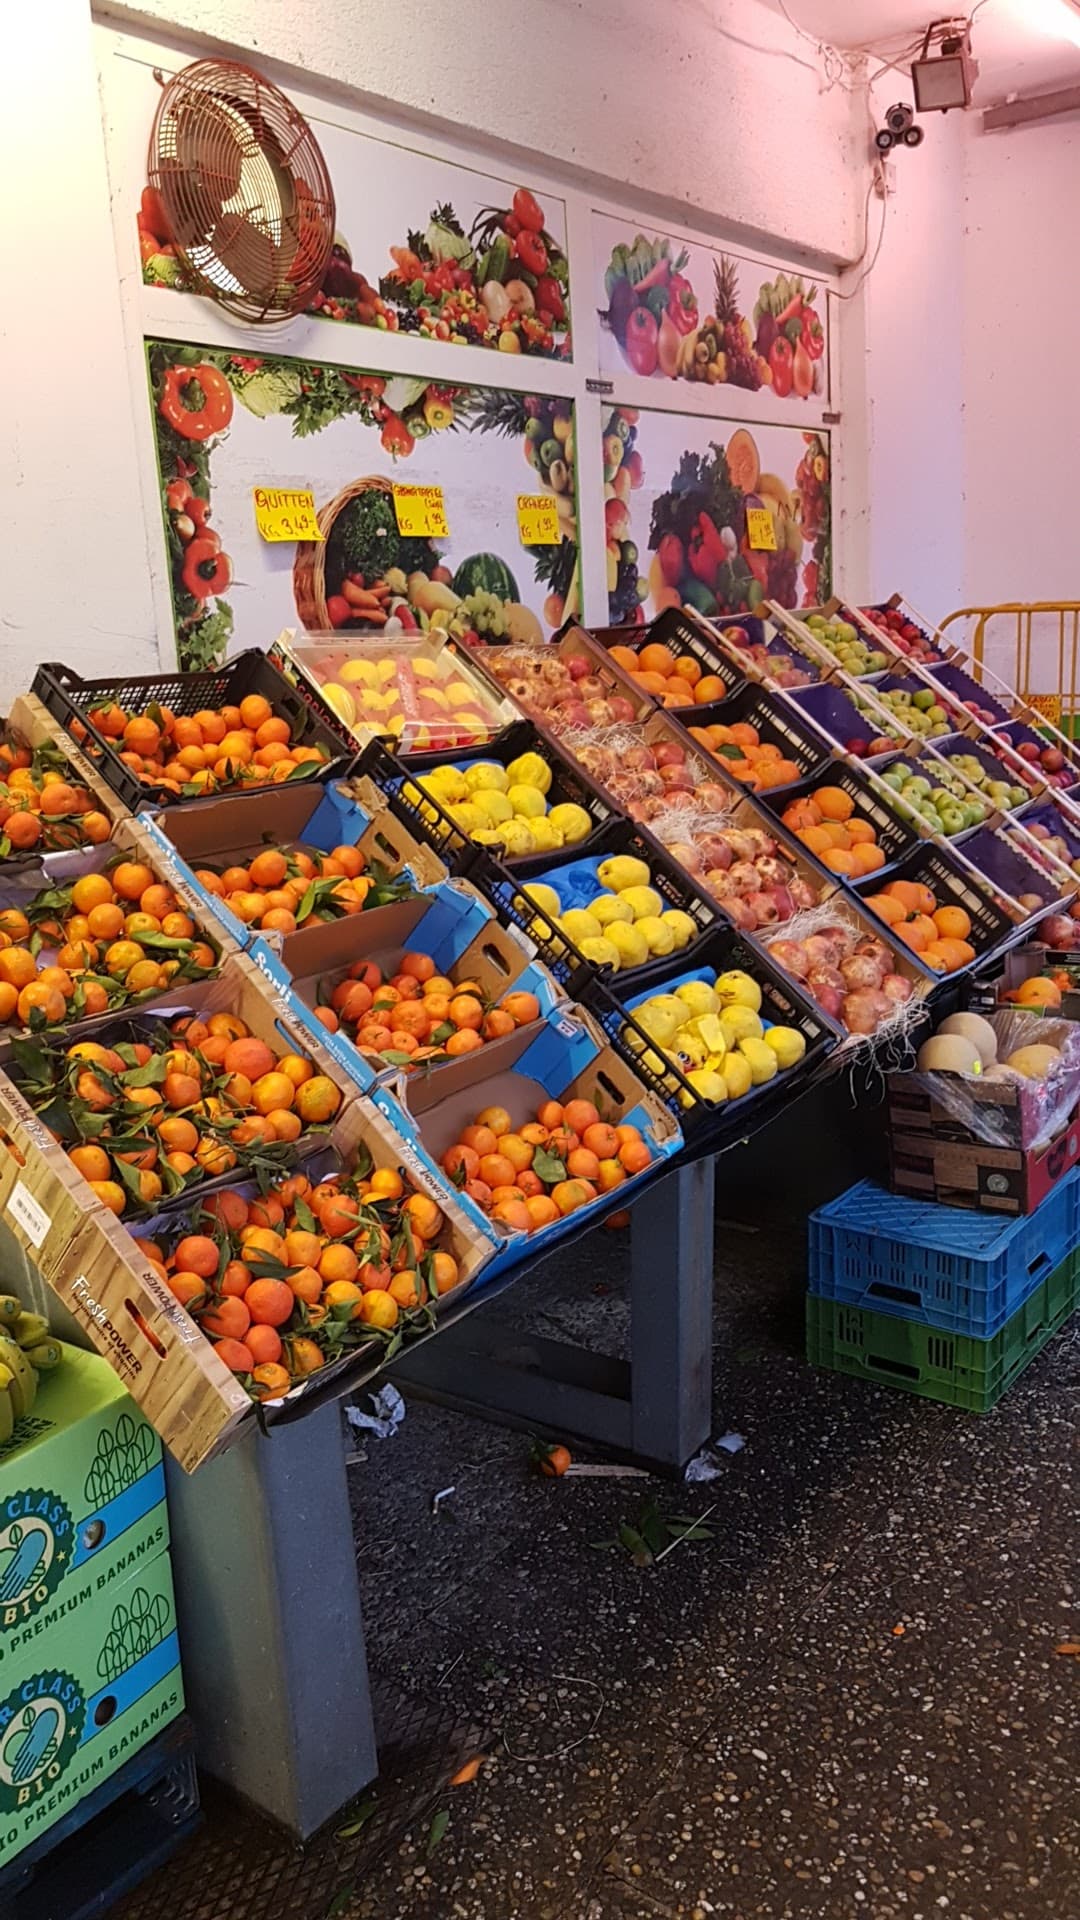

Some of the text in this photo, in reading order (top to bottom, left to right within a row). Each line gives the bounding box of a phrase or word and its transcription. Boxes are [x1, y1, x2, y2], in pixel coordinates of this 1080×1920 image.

[7, 1495, 70, 1537] CLASS
[4, 1584, 49, 1626] BIO
[10, 1526, 164, 1653] PREMIUM BANANAS
[21, 1676, 81, 1714] CLASS
[24, 1757, 104, 1831] PREMIUM
[109, 1691, 178, 1761] BANANAS
[17, 1761, 61, 1805] BIO
